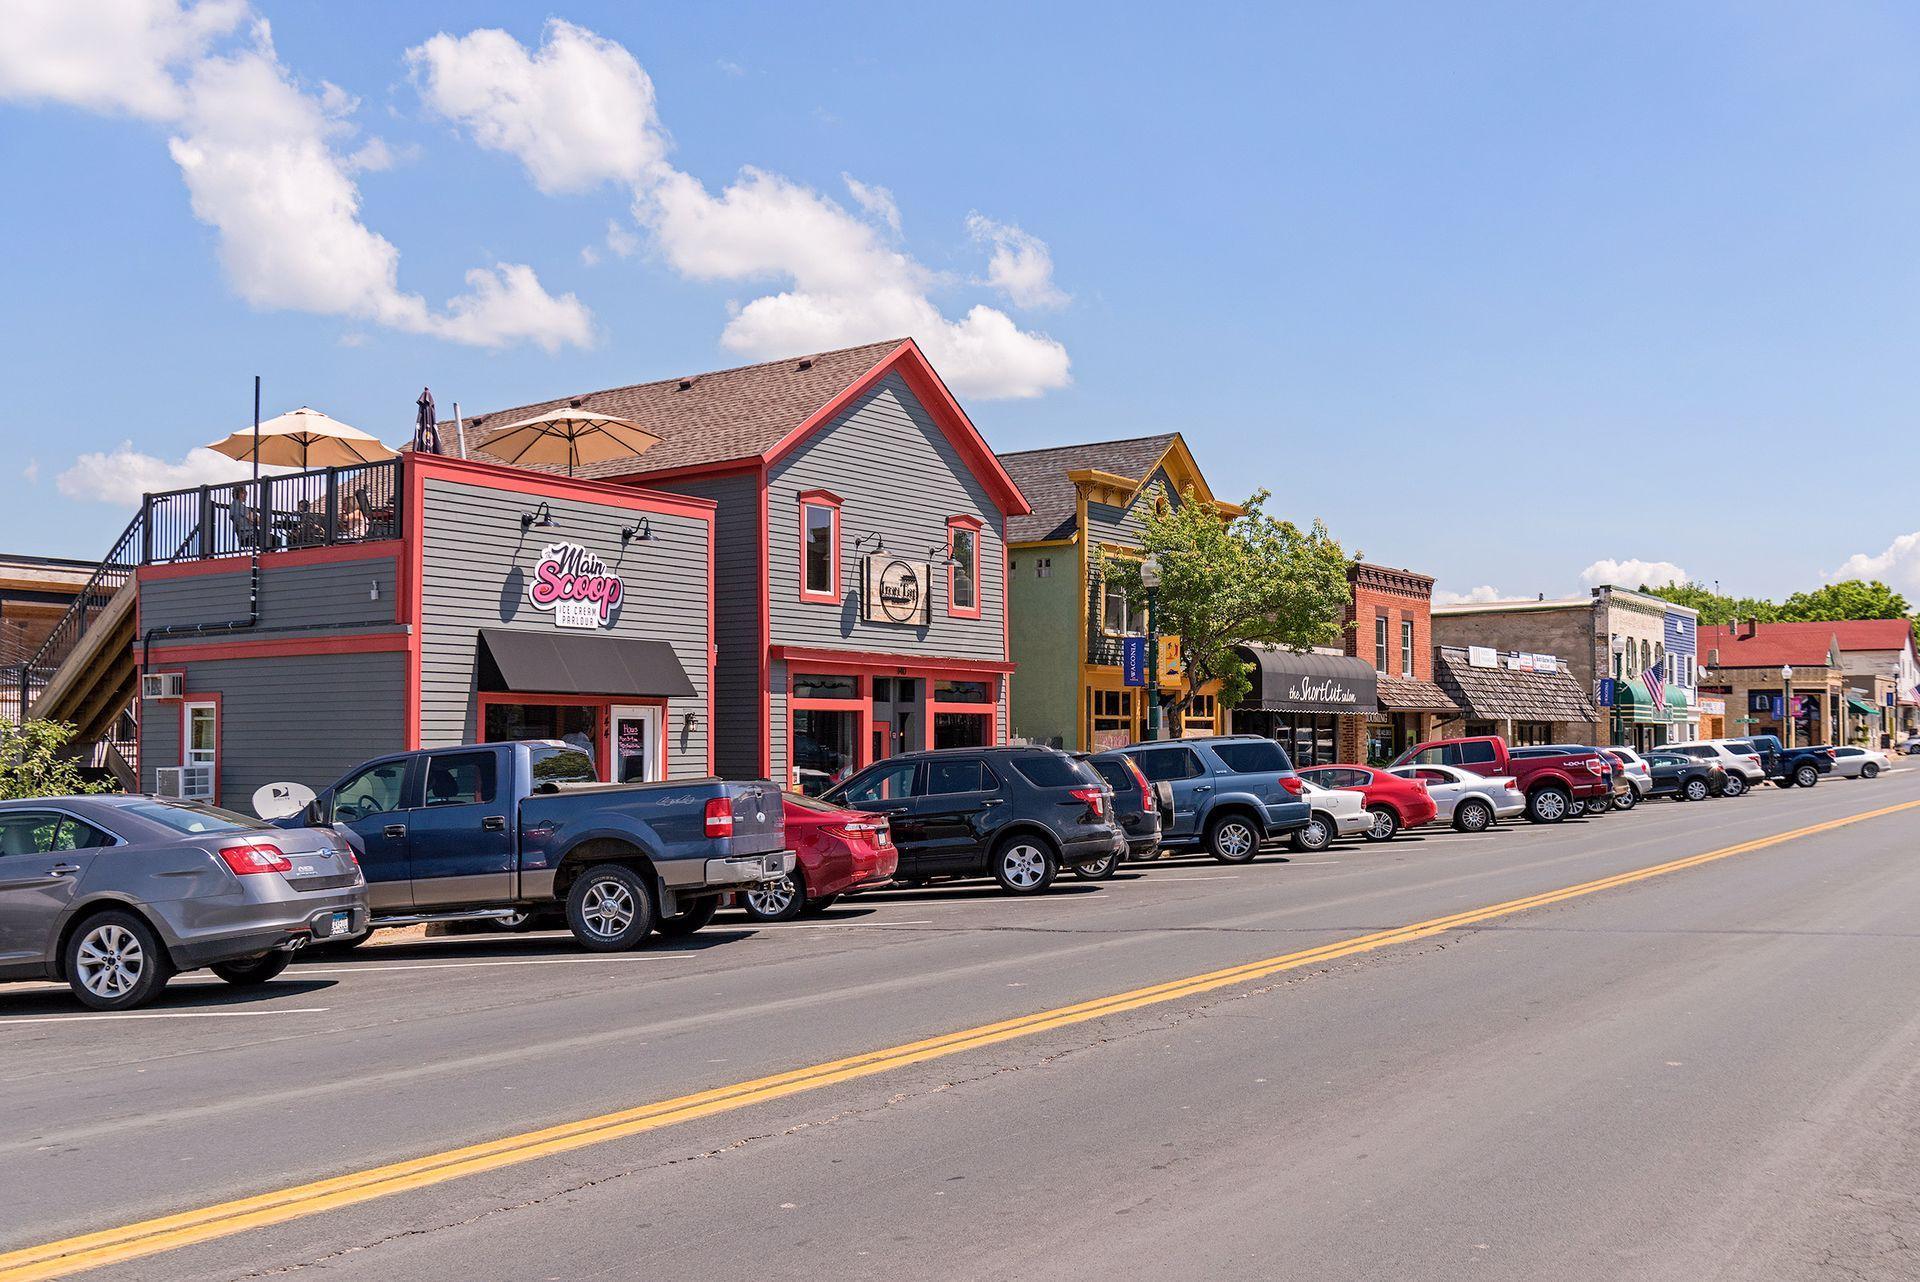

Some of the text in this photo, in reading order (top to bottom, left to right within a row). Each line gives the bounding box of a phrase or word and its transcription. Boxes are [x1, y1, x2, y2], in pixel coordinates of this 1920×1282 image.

[551, 545, 605, 576] Main
[533, 560, 620, 619] Scoop
[559, 604, 597, 617] ICE CREAM
[561, 615, 594, 626] PARLOUR
[1288, 685, 1300, 700] the
